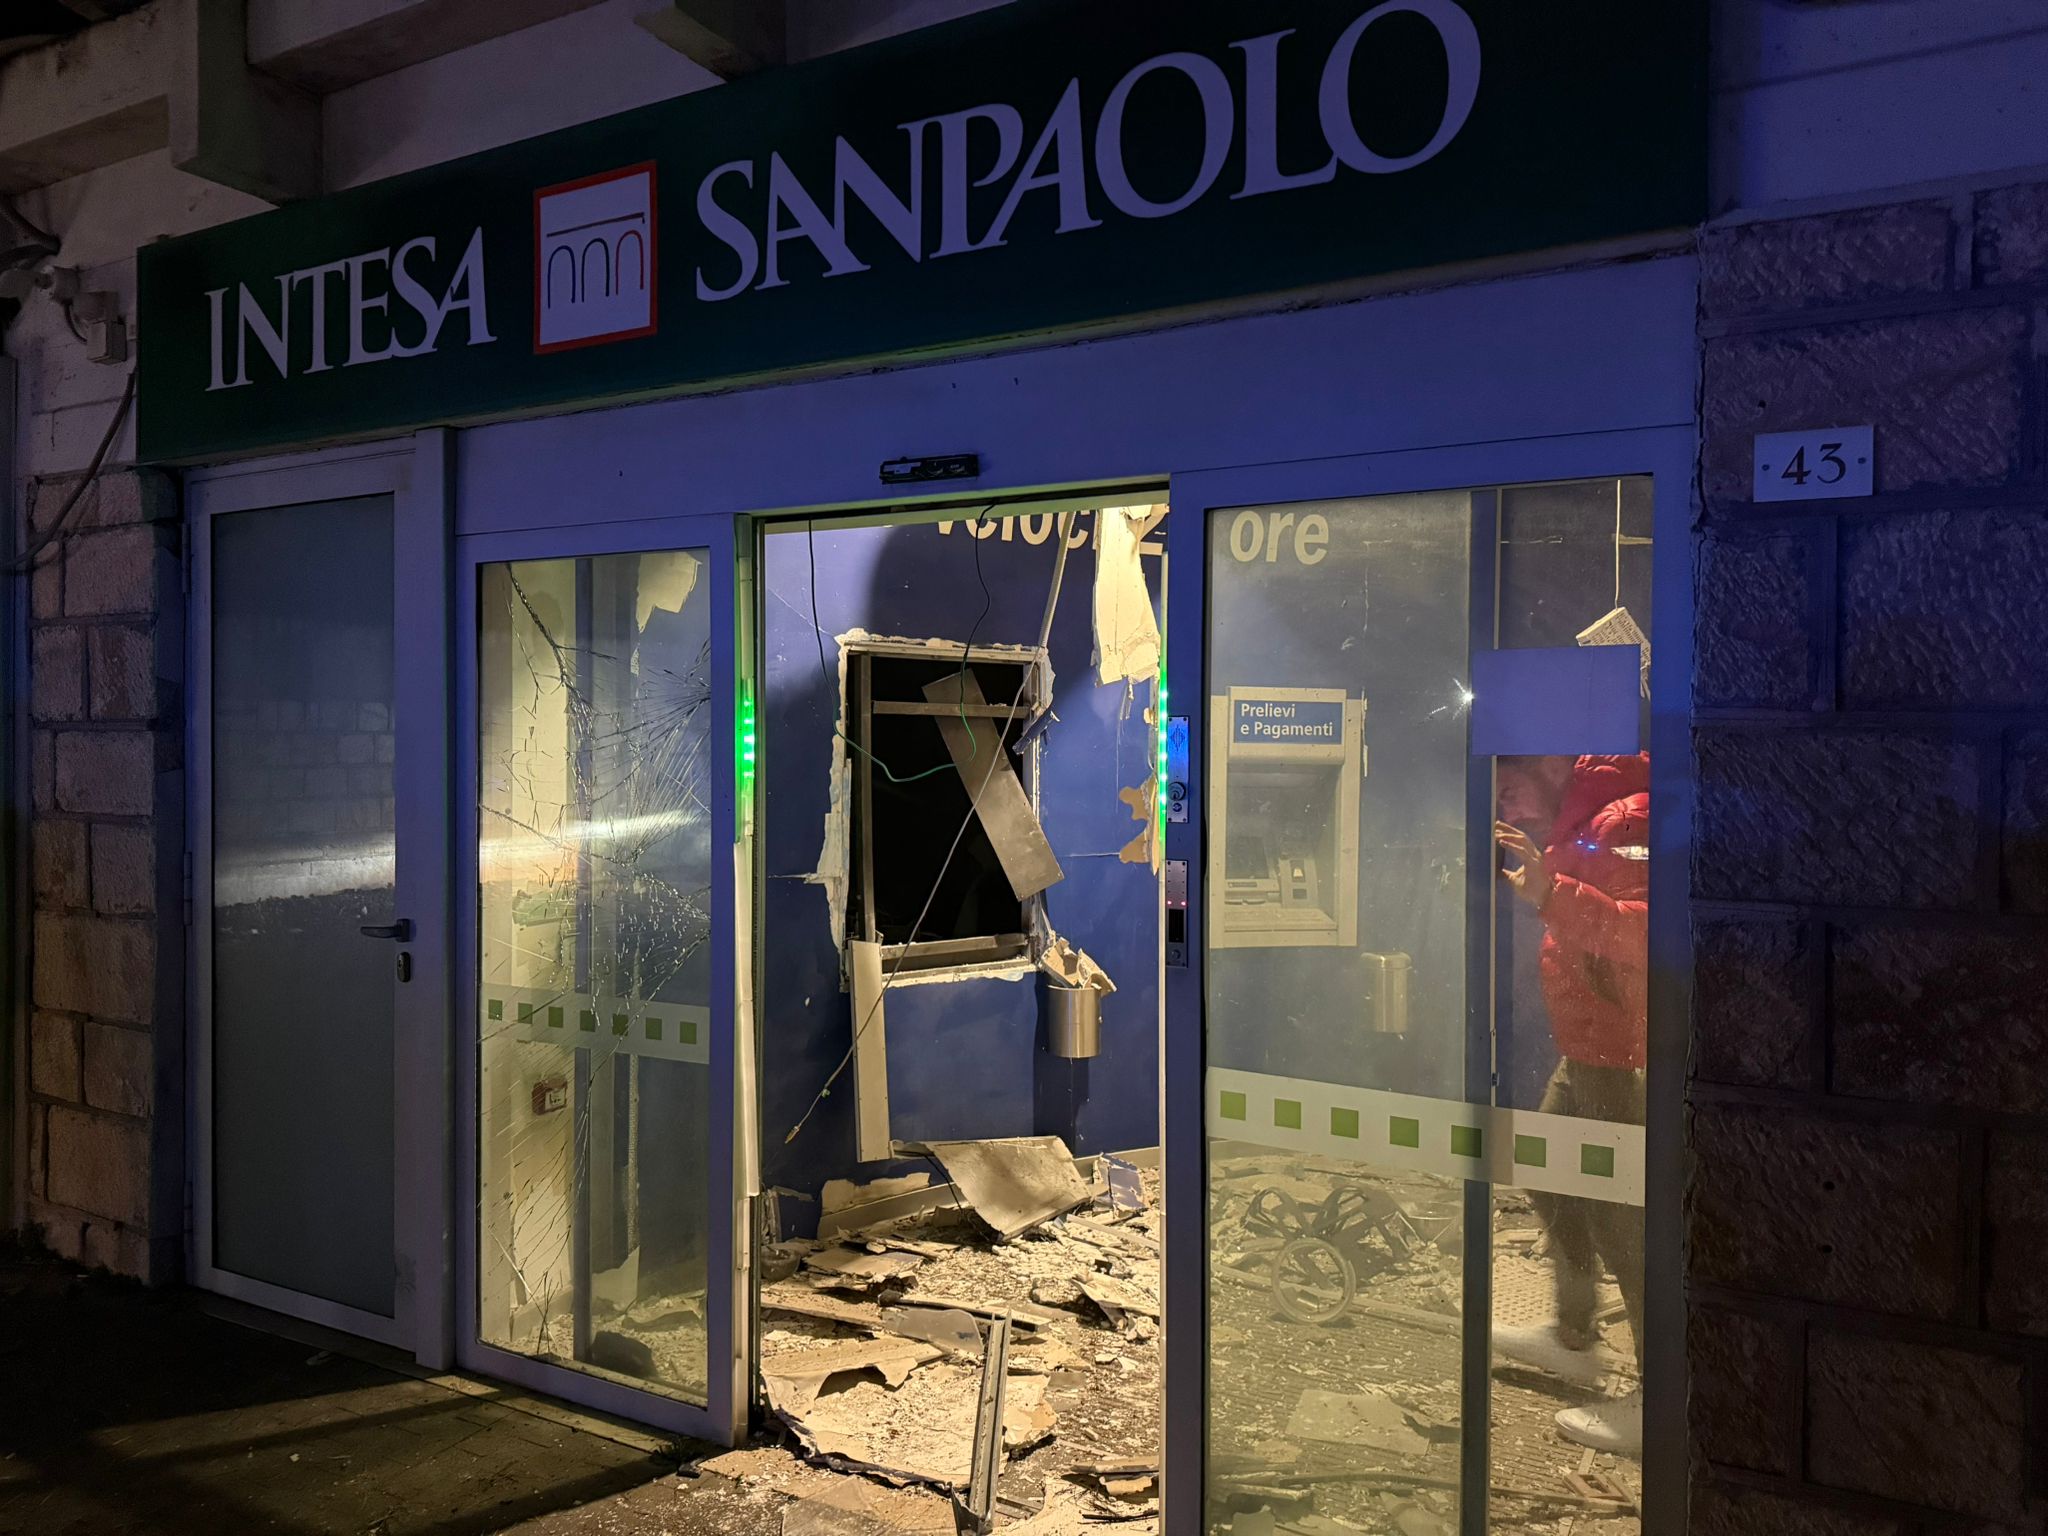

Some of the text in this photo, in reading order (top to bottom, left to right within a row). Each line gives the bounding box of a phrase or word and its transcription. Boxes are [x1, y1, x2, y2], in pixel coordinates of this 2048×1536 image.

[204, 0, 1482, 393] INTESA SANPAOLO
[1780, 442, 1847, 486] 43
[1229, 510, 1329, 565] ore
[1240, 702, 1297, 718] Prelievi
[1240, 721, 1334, 739] e Pagamenti
